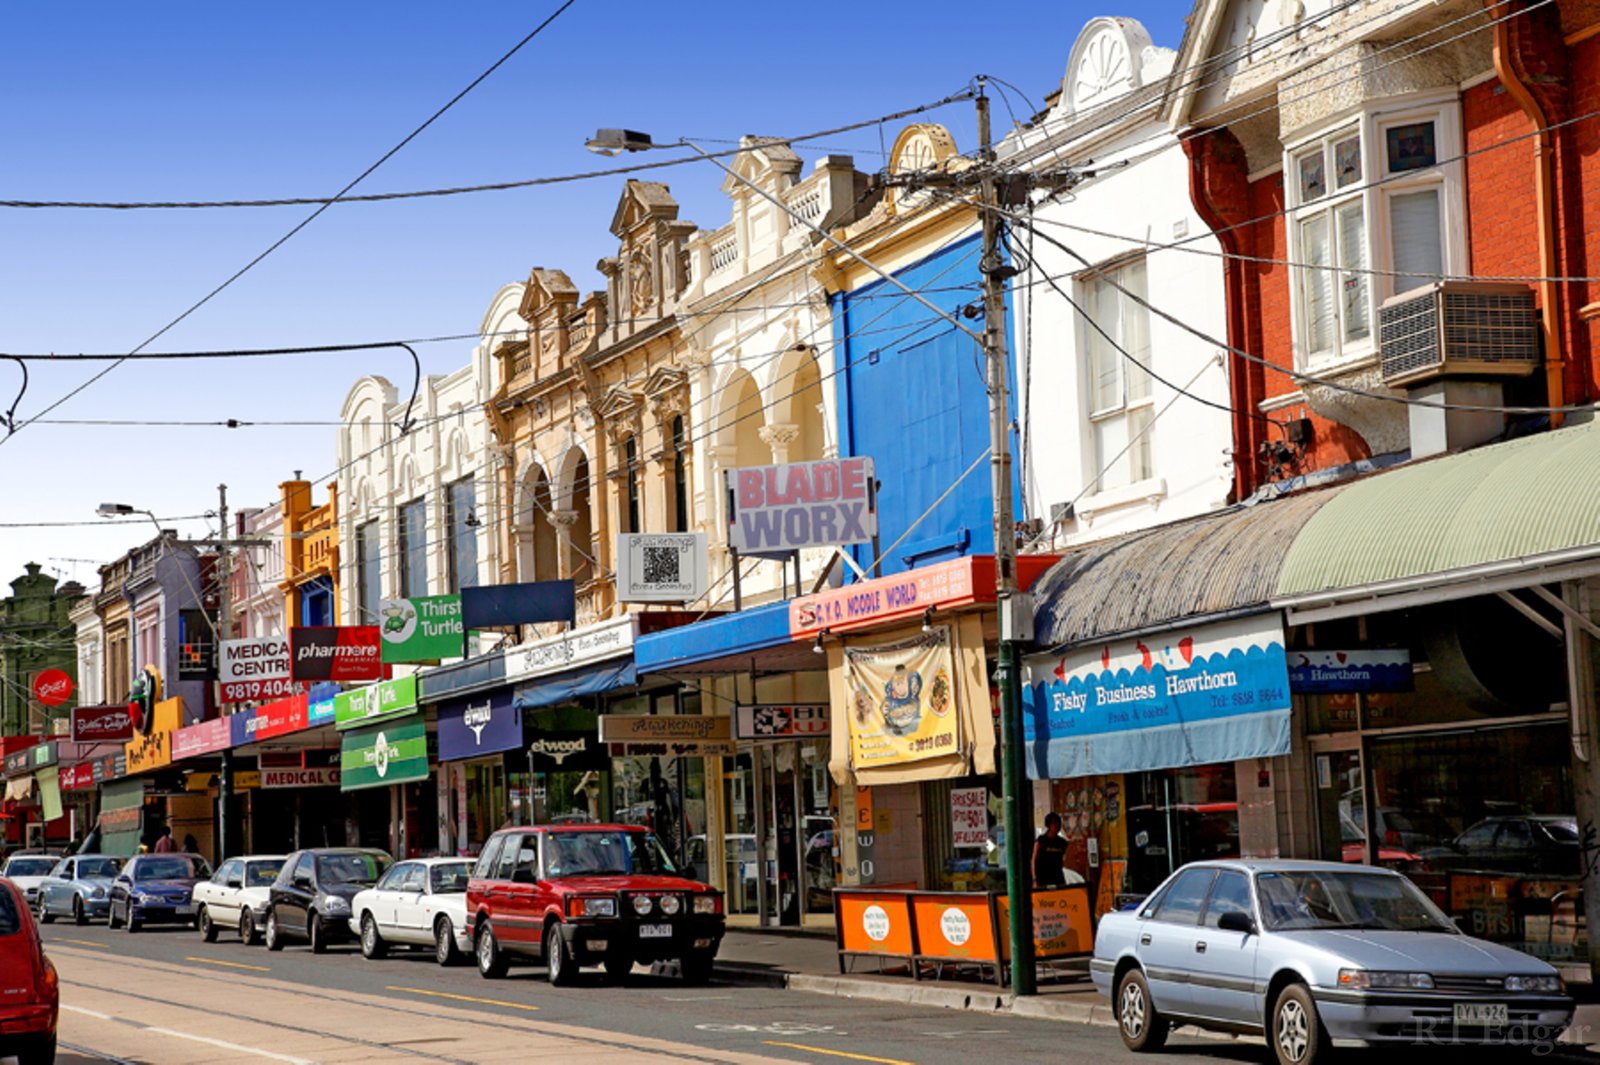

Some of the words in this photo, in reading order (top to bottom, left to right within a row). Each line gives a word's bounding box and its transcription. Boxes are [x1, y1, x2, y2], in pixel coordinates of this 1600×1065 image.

[737, 460, 866, 509] BLADE
[740, 502, 867, 548] WORX
[421, 600, 462, 617] Thirst
[847, 591, 881, 617] NOODLE
[885, 582, 917, 610] WORLD
[421, 619, 464, 637] Turtle
[227, 642, 289, 660] MEDICA
[298, 643, 377, 660] pharmore
[1311, 669, 1371, 681] Hawthorn
[225, 681, 260, 699] 9819
[1052, 689, 1088, 713] Fishy
[1095, 682, 1156, 706] Business
[1165, 669, 1238, 696] Hawthorn
[531, 737, 587, 752] elwood
[266, 772, 323, 785] MEDICAL
